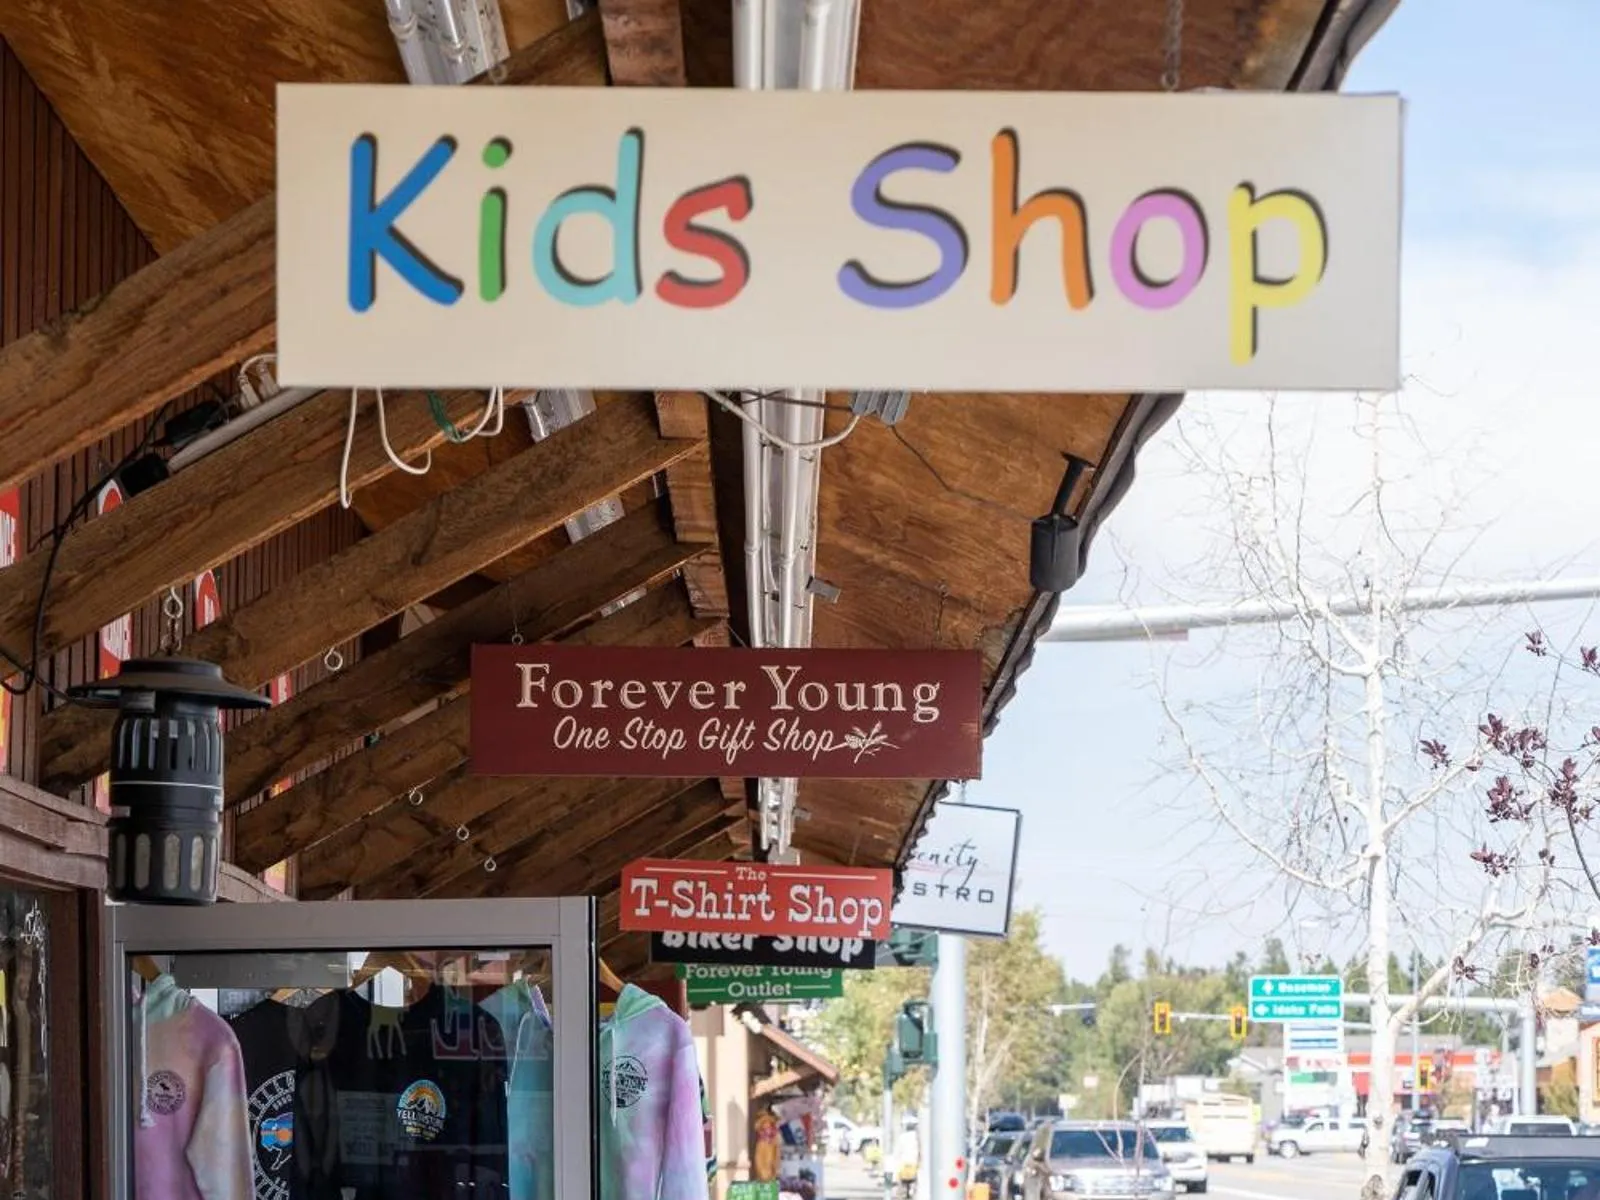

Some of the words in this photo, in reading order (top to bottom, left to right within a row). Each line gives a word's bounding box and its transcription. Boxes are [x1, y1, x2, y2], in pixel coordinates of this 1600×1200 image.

[349, 126, 753, 312] Kids
[837, 126, 1328, 366] Shop
[515, 663, 747, 710] Forever
[760, 665, 941, 723] Young
[553, 715, 609, 751] One
[620, 717, 687, 760] Stop
[698, 717, 757, 765] Gift
[763, 717, 835, 761] Shop
[736, 867, 766, 881] The
[630, 878, 776, 922] T-Shirt
[788, 884, 883, 937] Shop
[686, 963, 763, 979] Forever
[728, 981, 793, 998] Outlet
